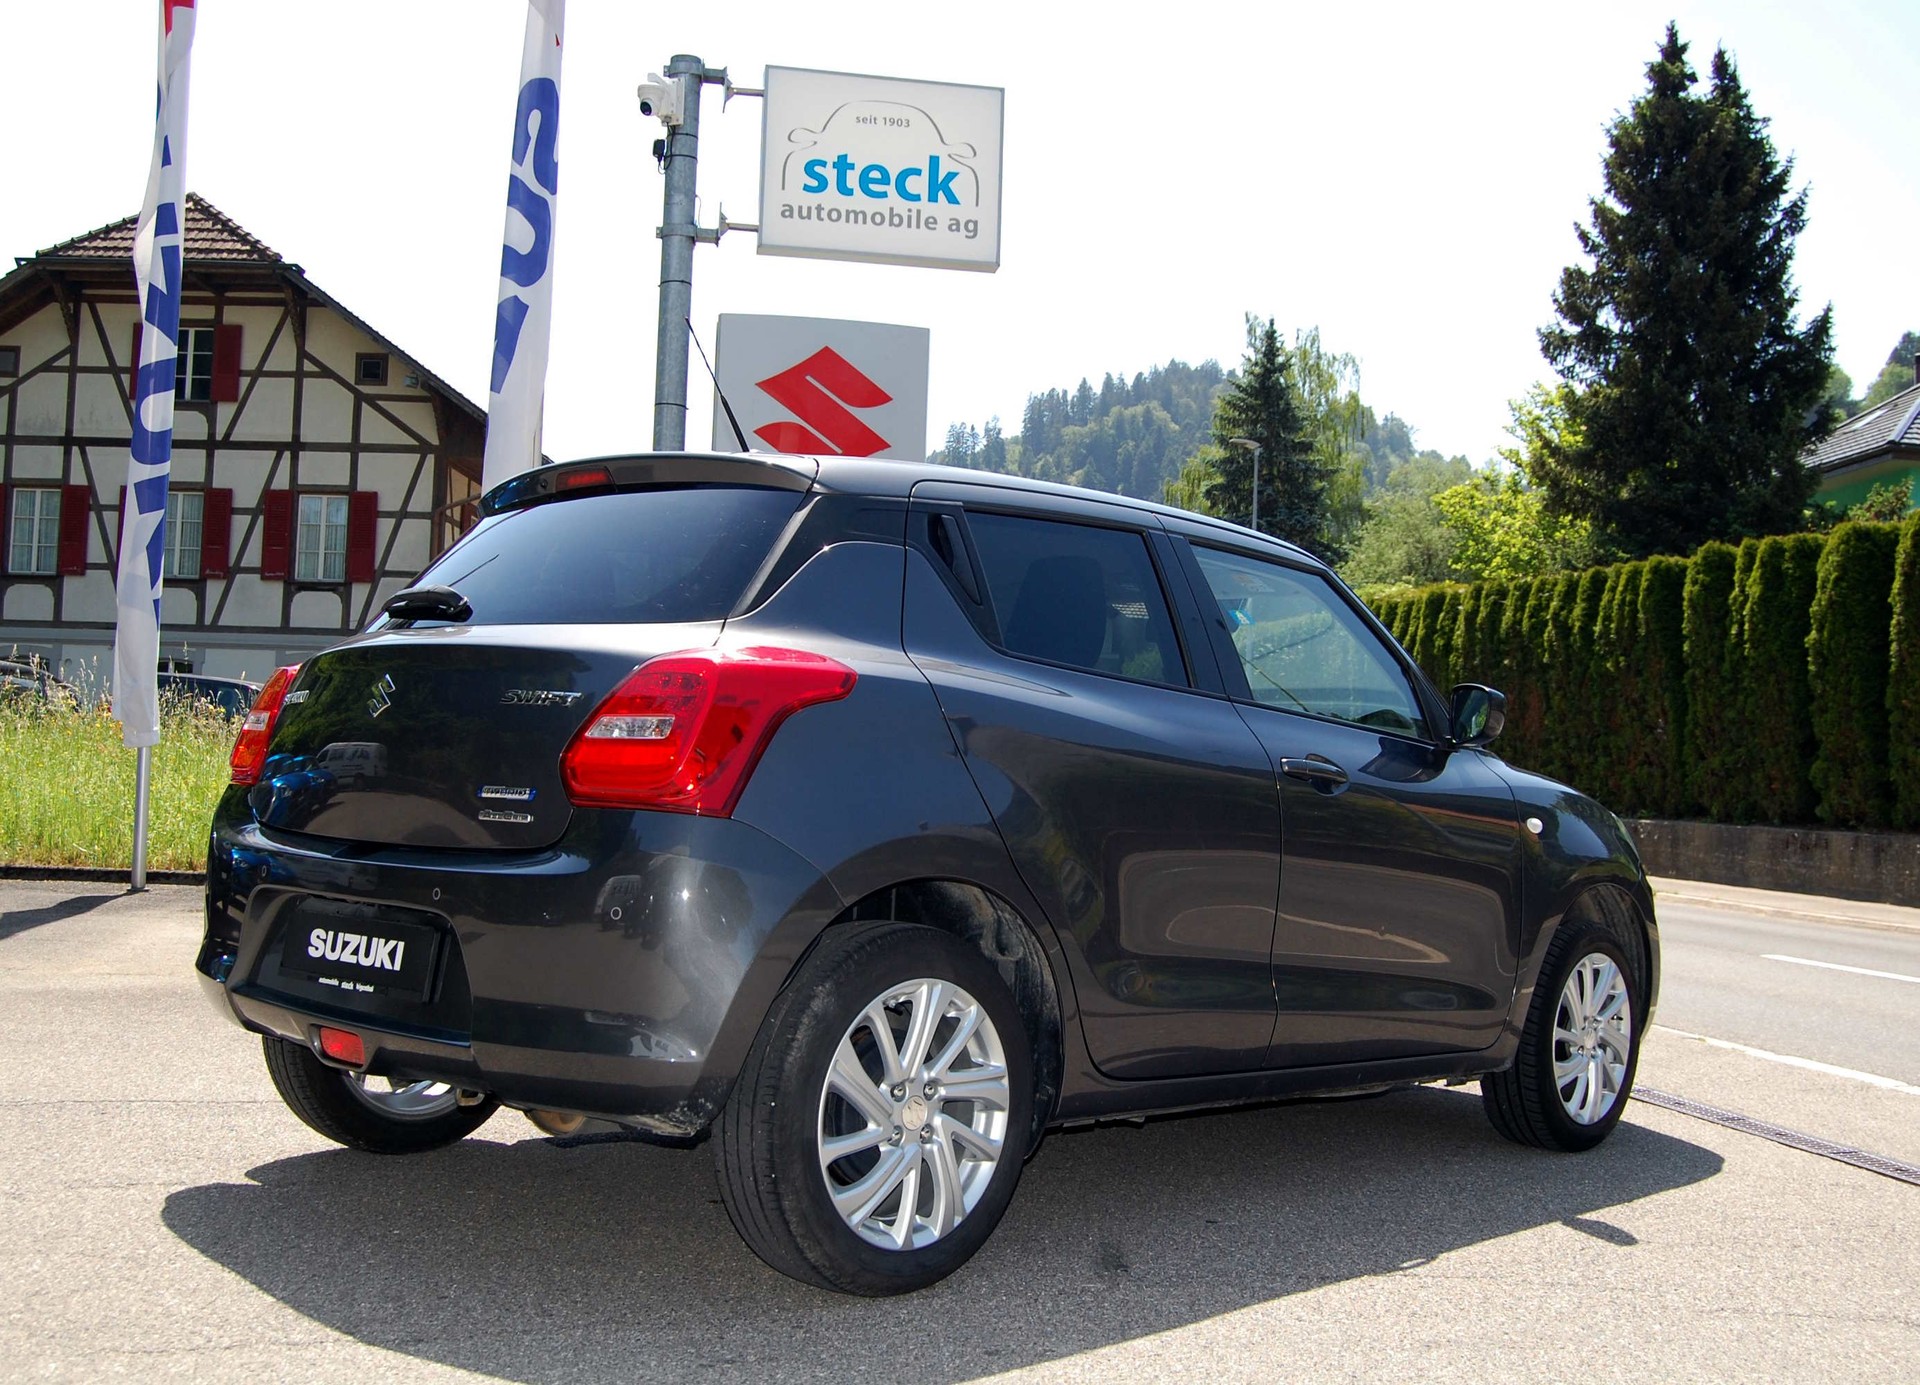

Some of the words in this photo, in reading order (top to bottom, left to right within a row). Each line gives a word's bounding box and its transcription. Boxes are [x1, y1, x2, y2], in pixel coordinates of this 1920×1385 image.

[855, 114, 878, 126] seit
[882, 117, 911, 128] 1903
[802, 153, 961, 205] steck
[780, 203, 938, 231] automobile
[947, 216, 979, 239] ag
[501, 689, 583, 706] SWIFT
[308, 928, 405, 971] SUZUKI
